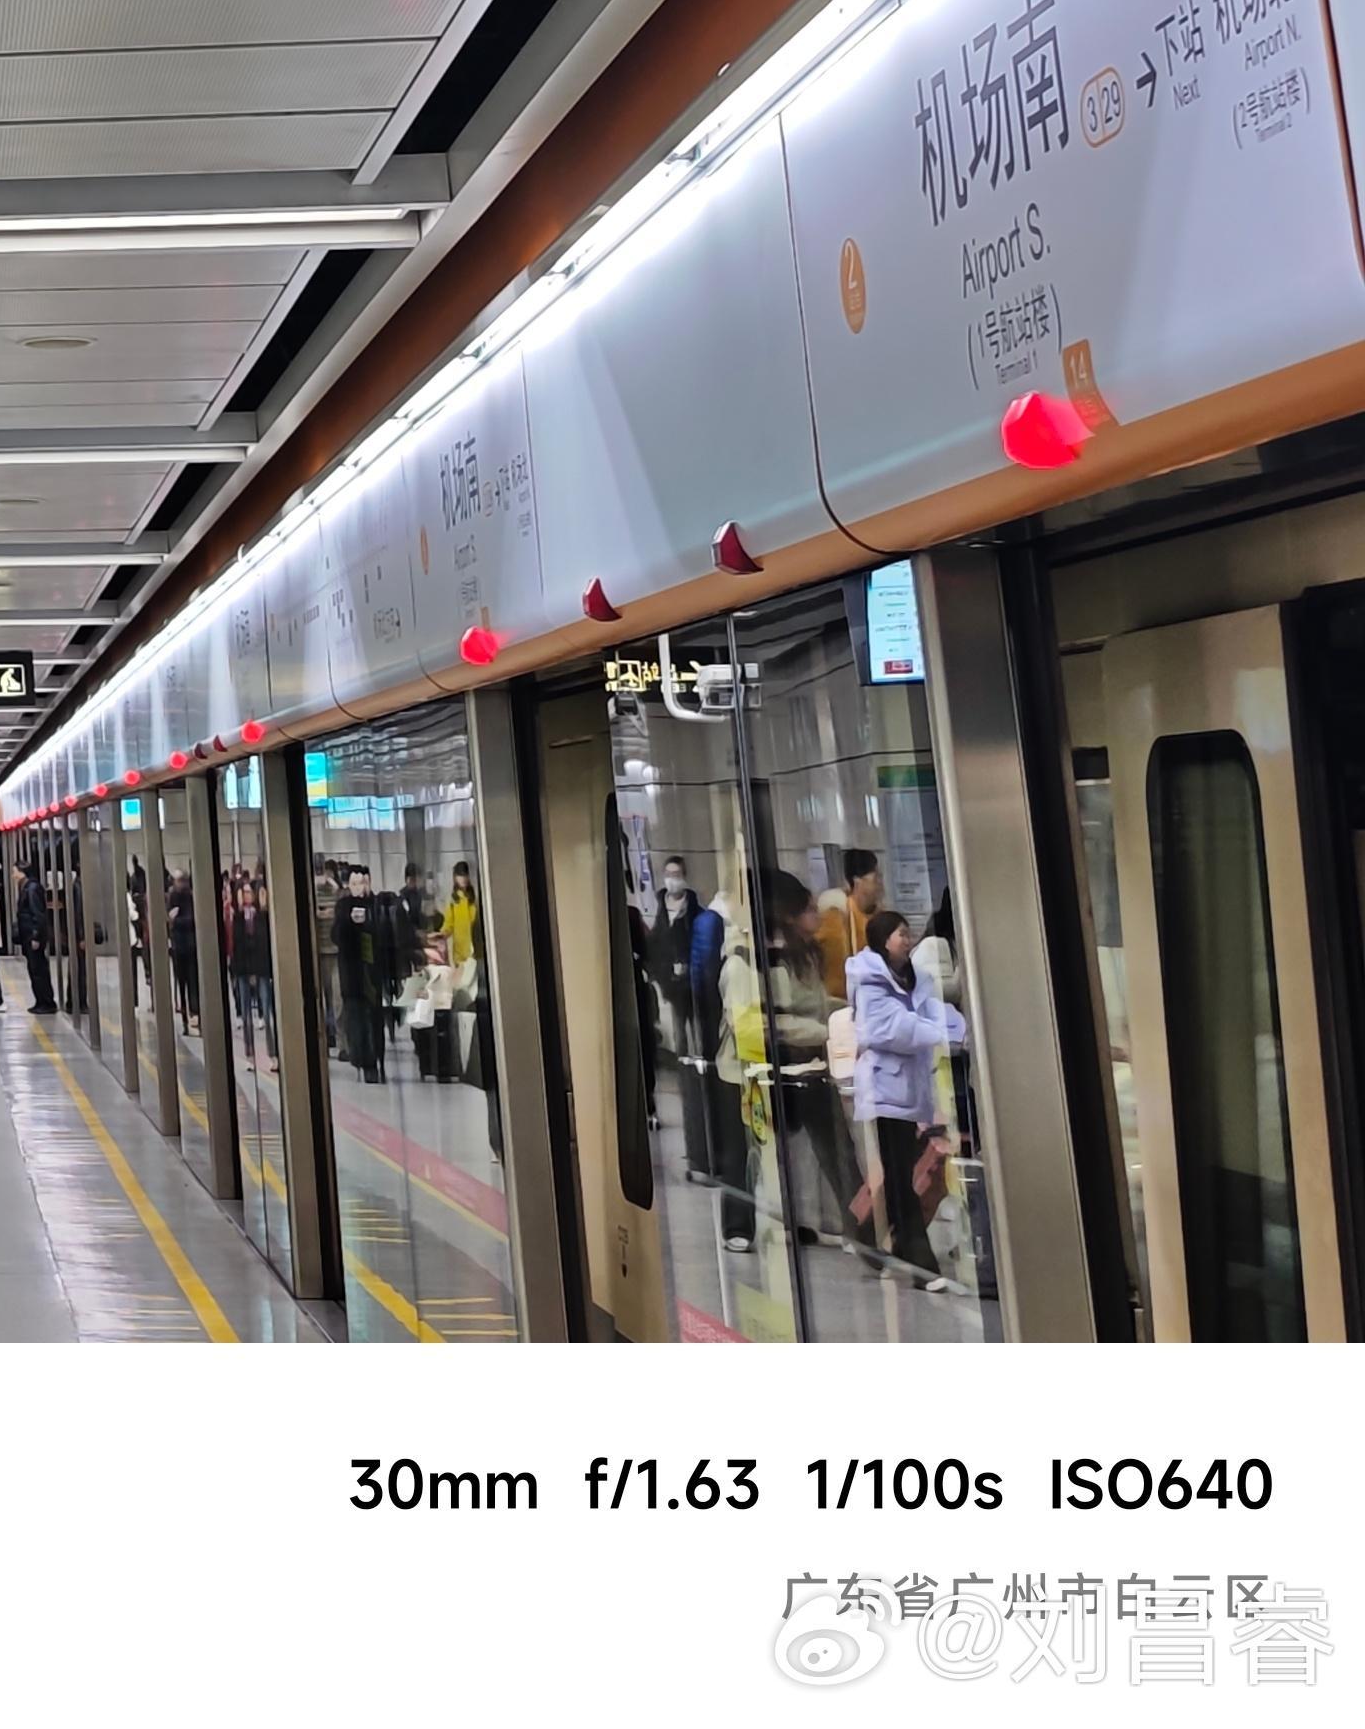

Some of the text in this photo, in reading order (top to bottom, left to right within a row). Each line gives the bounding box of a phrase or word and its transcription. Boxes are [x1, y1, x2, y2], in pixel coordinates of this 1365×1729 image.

[1244, 23, 1286, 70] Airport
[1086, 81, 1122, 132] 3 29
[1173, 74, 1201, 111] Next
[963, 202, 1051, 299] Airport S.
[1070, 350, 1088, 389] 14
